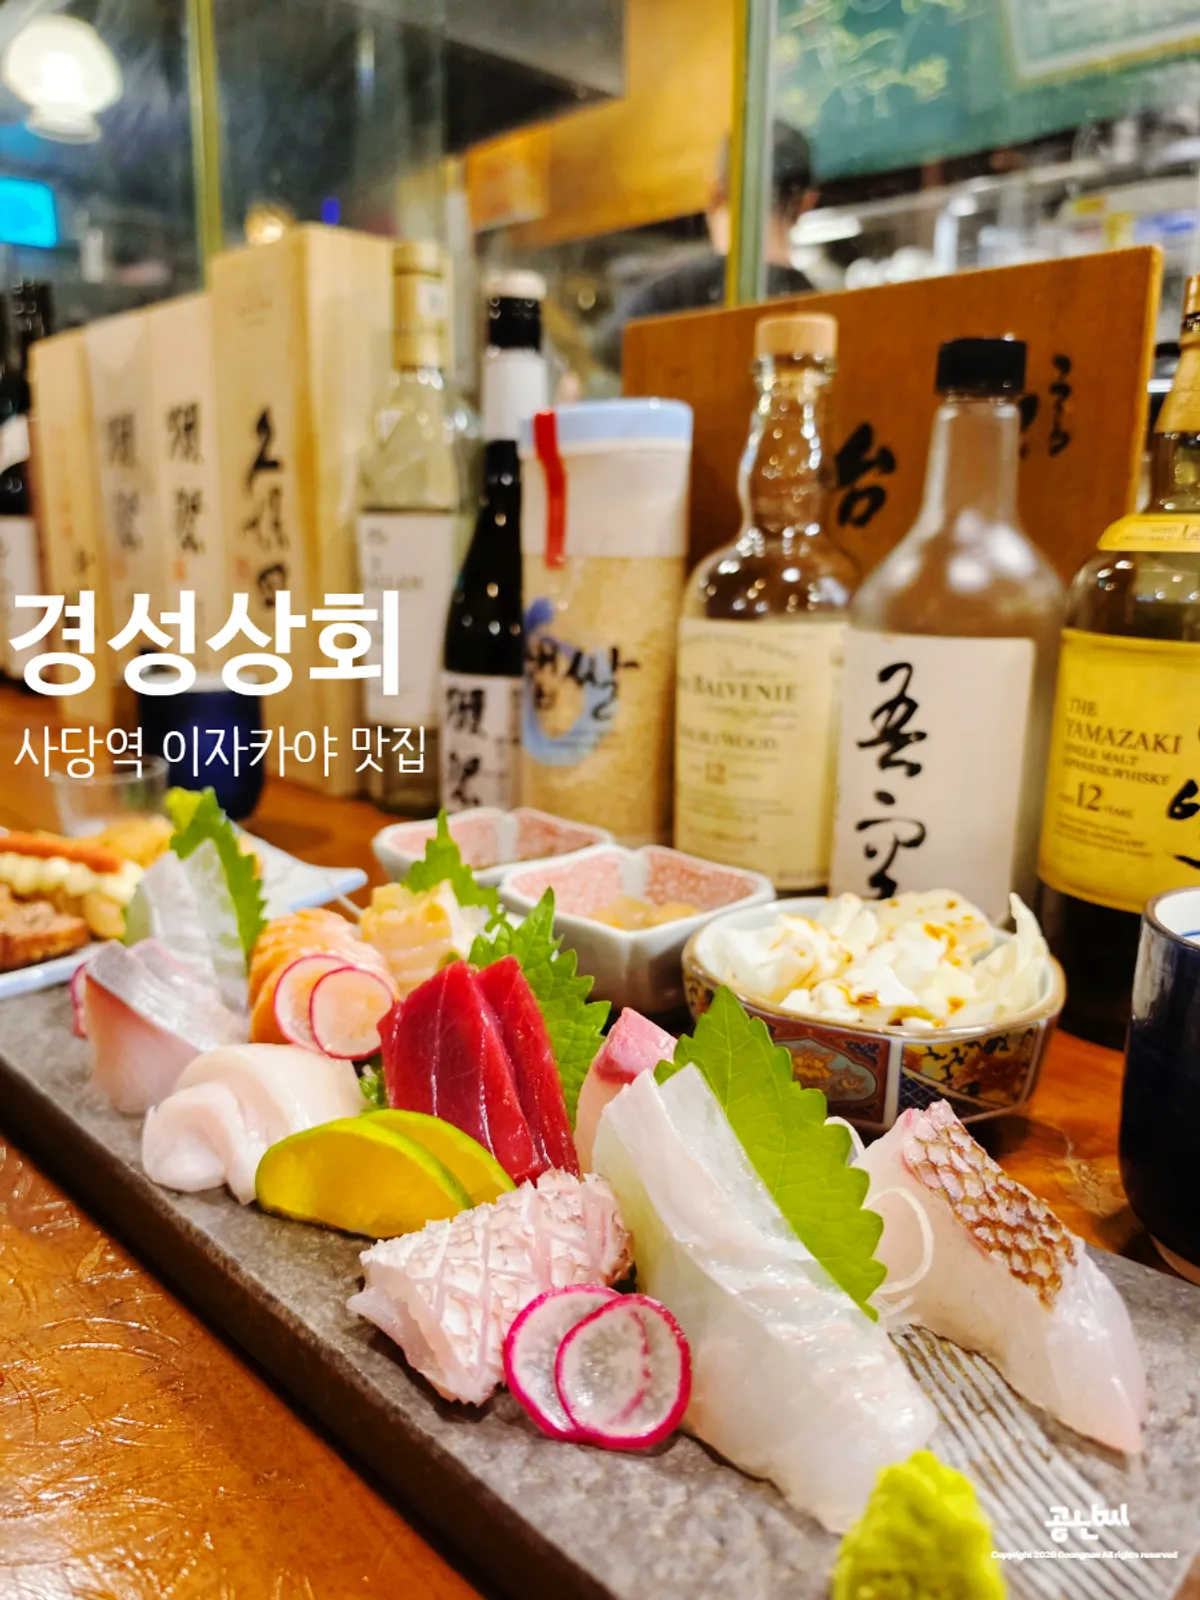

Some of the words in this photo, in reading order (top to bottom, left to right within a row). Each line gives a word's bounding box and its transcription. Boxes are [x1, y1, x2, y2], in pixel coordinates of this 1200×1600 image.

[1068, 698, 1097, 718] THE
[1065, 718, 1183, 756] YAMAZAKI
[1101, 751, 1140, 767] MALT
[1112, 768, 1171, 787] WHISKY
[1076, 781, 1103, 812] 12
